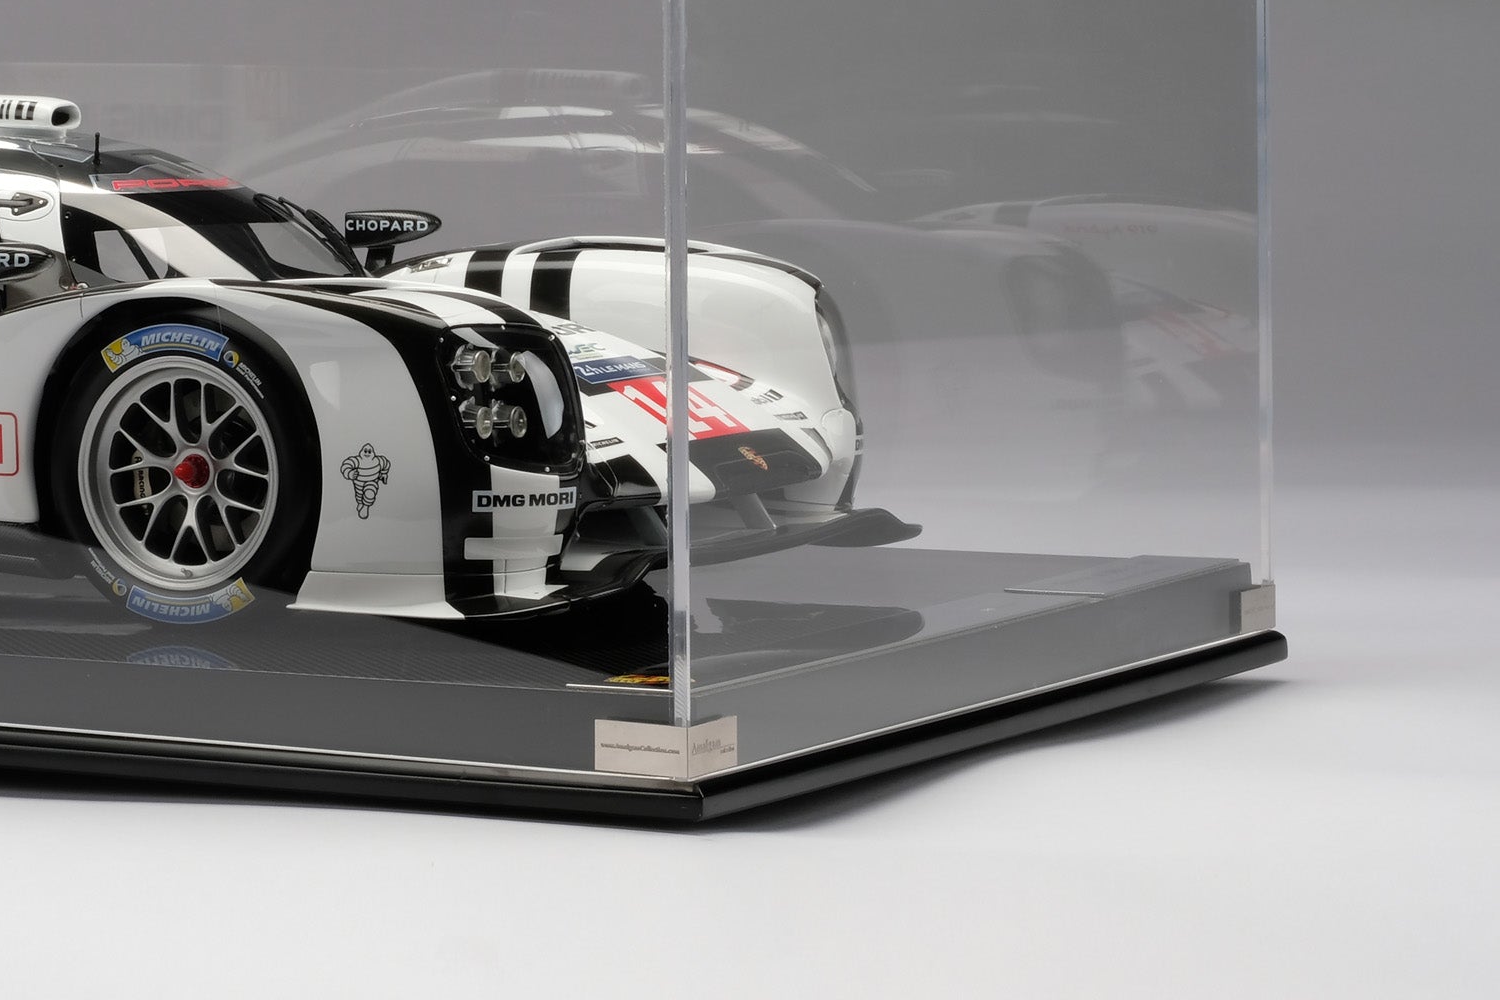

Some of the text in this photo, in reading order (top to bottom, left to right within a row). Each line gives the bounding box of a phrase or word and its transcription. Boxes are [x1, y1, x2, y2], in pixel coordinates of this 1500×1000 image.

[345, 219, 429, 232] CHOPARD
[141, 331, 220, 352] MICHELIN
[477, 491, 574, 508] DMG MORI
[131, 596, 211, 617] MICHELIN
